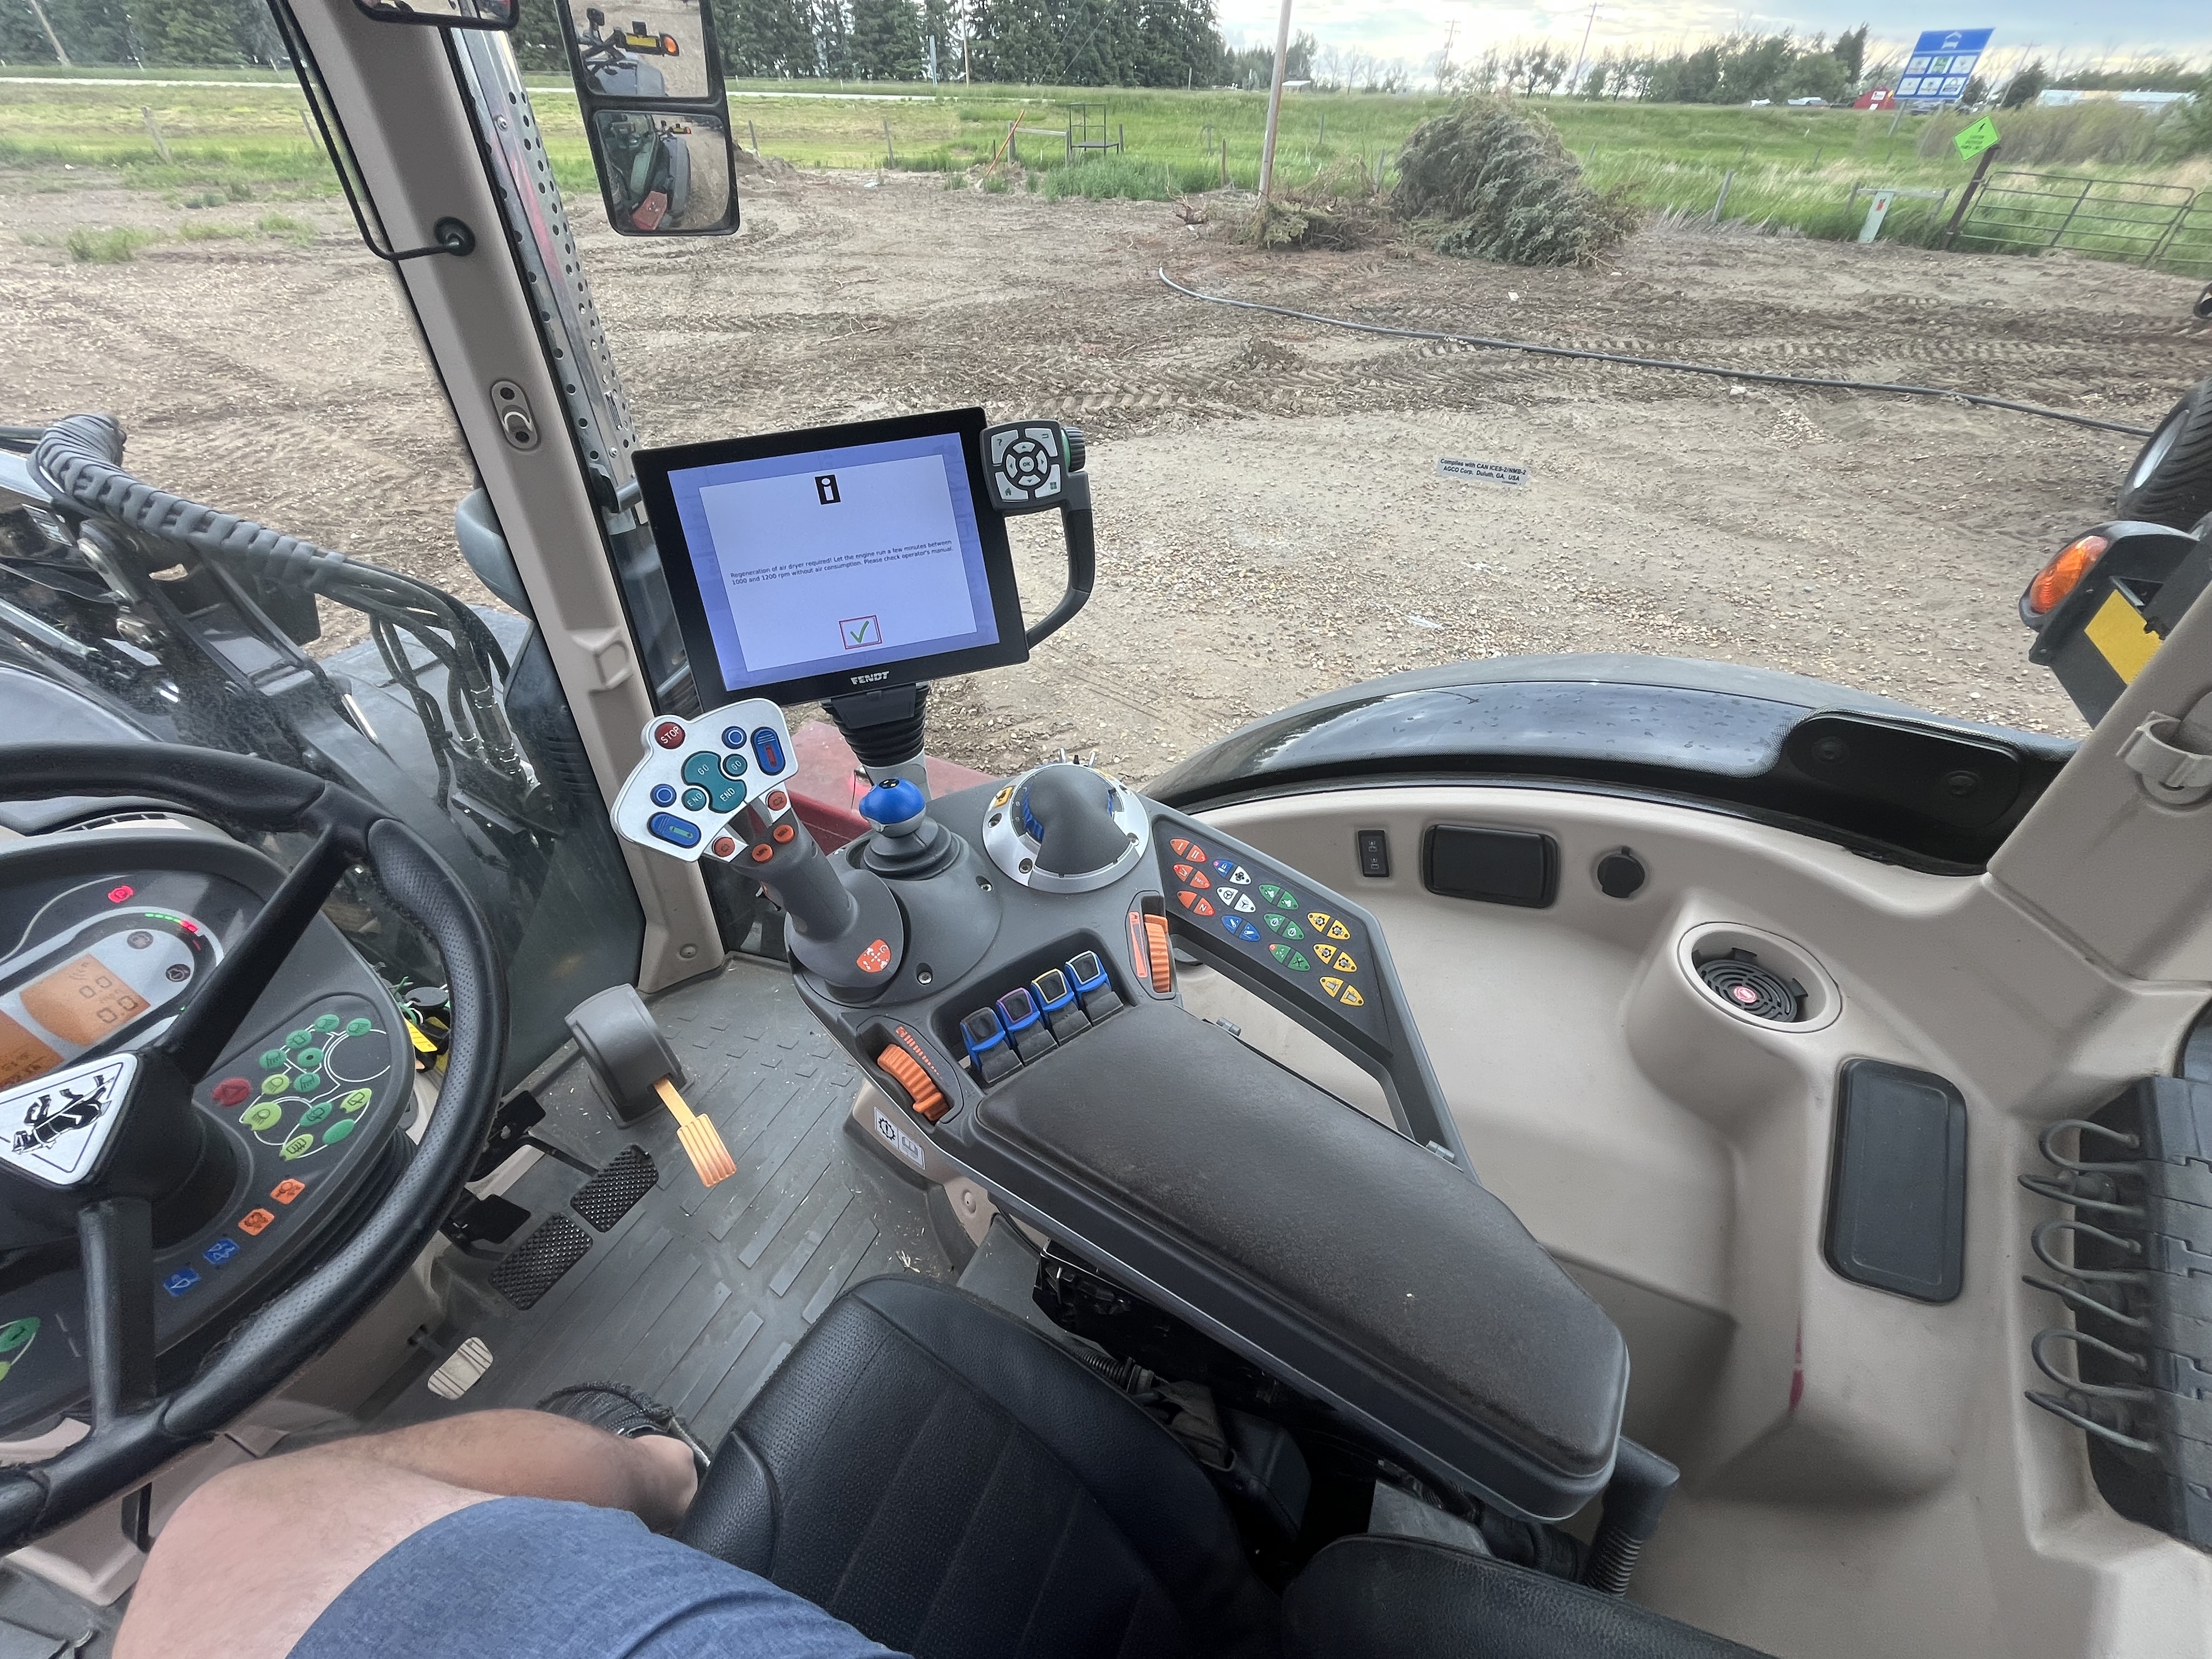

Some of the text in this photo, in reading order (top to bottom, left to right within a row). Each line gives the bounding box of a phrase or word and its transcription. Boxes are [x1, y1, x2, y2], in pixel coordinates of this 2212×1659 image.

[730, 568, 770, 578] Regeneration
[805, 558, 832, 566] required!
[928, 540, 952, 548] between
[824, 561, 862, 571] consumption.
[901, 550, 930, 559] operator's
[850, 670, 889, 685] FENDT
[661, 726, 679, 744] STOP
[697, 764, 709, 775] GO
[731, 760, 742, 770] GO
[687, 793, 703, 806] END
[720, 788, 735, 802] END
[773, 797, 785, 806] C2
[1177, 842, 1184, 850] I
[1193, 876, 1204, 885] TMS
[1199, 904, 1207, 912] N
